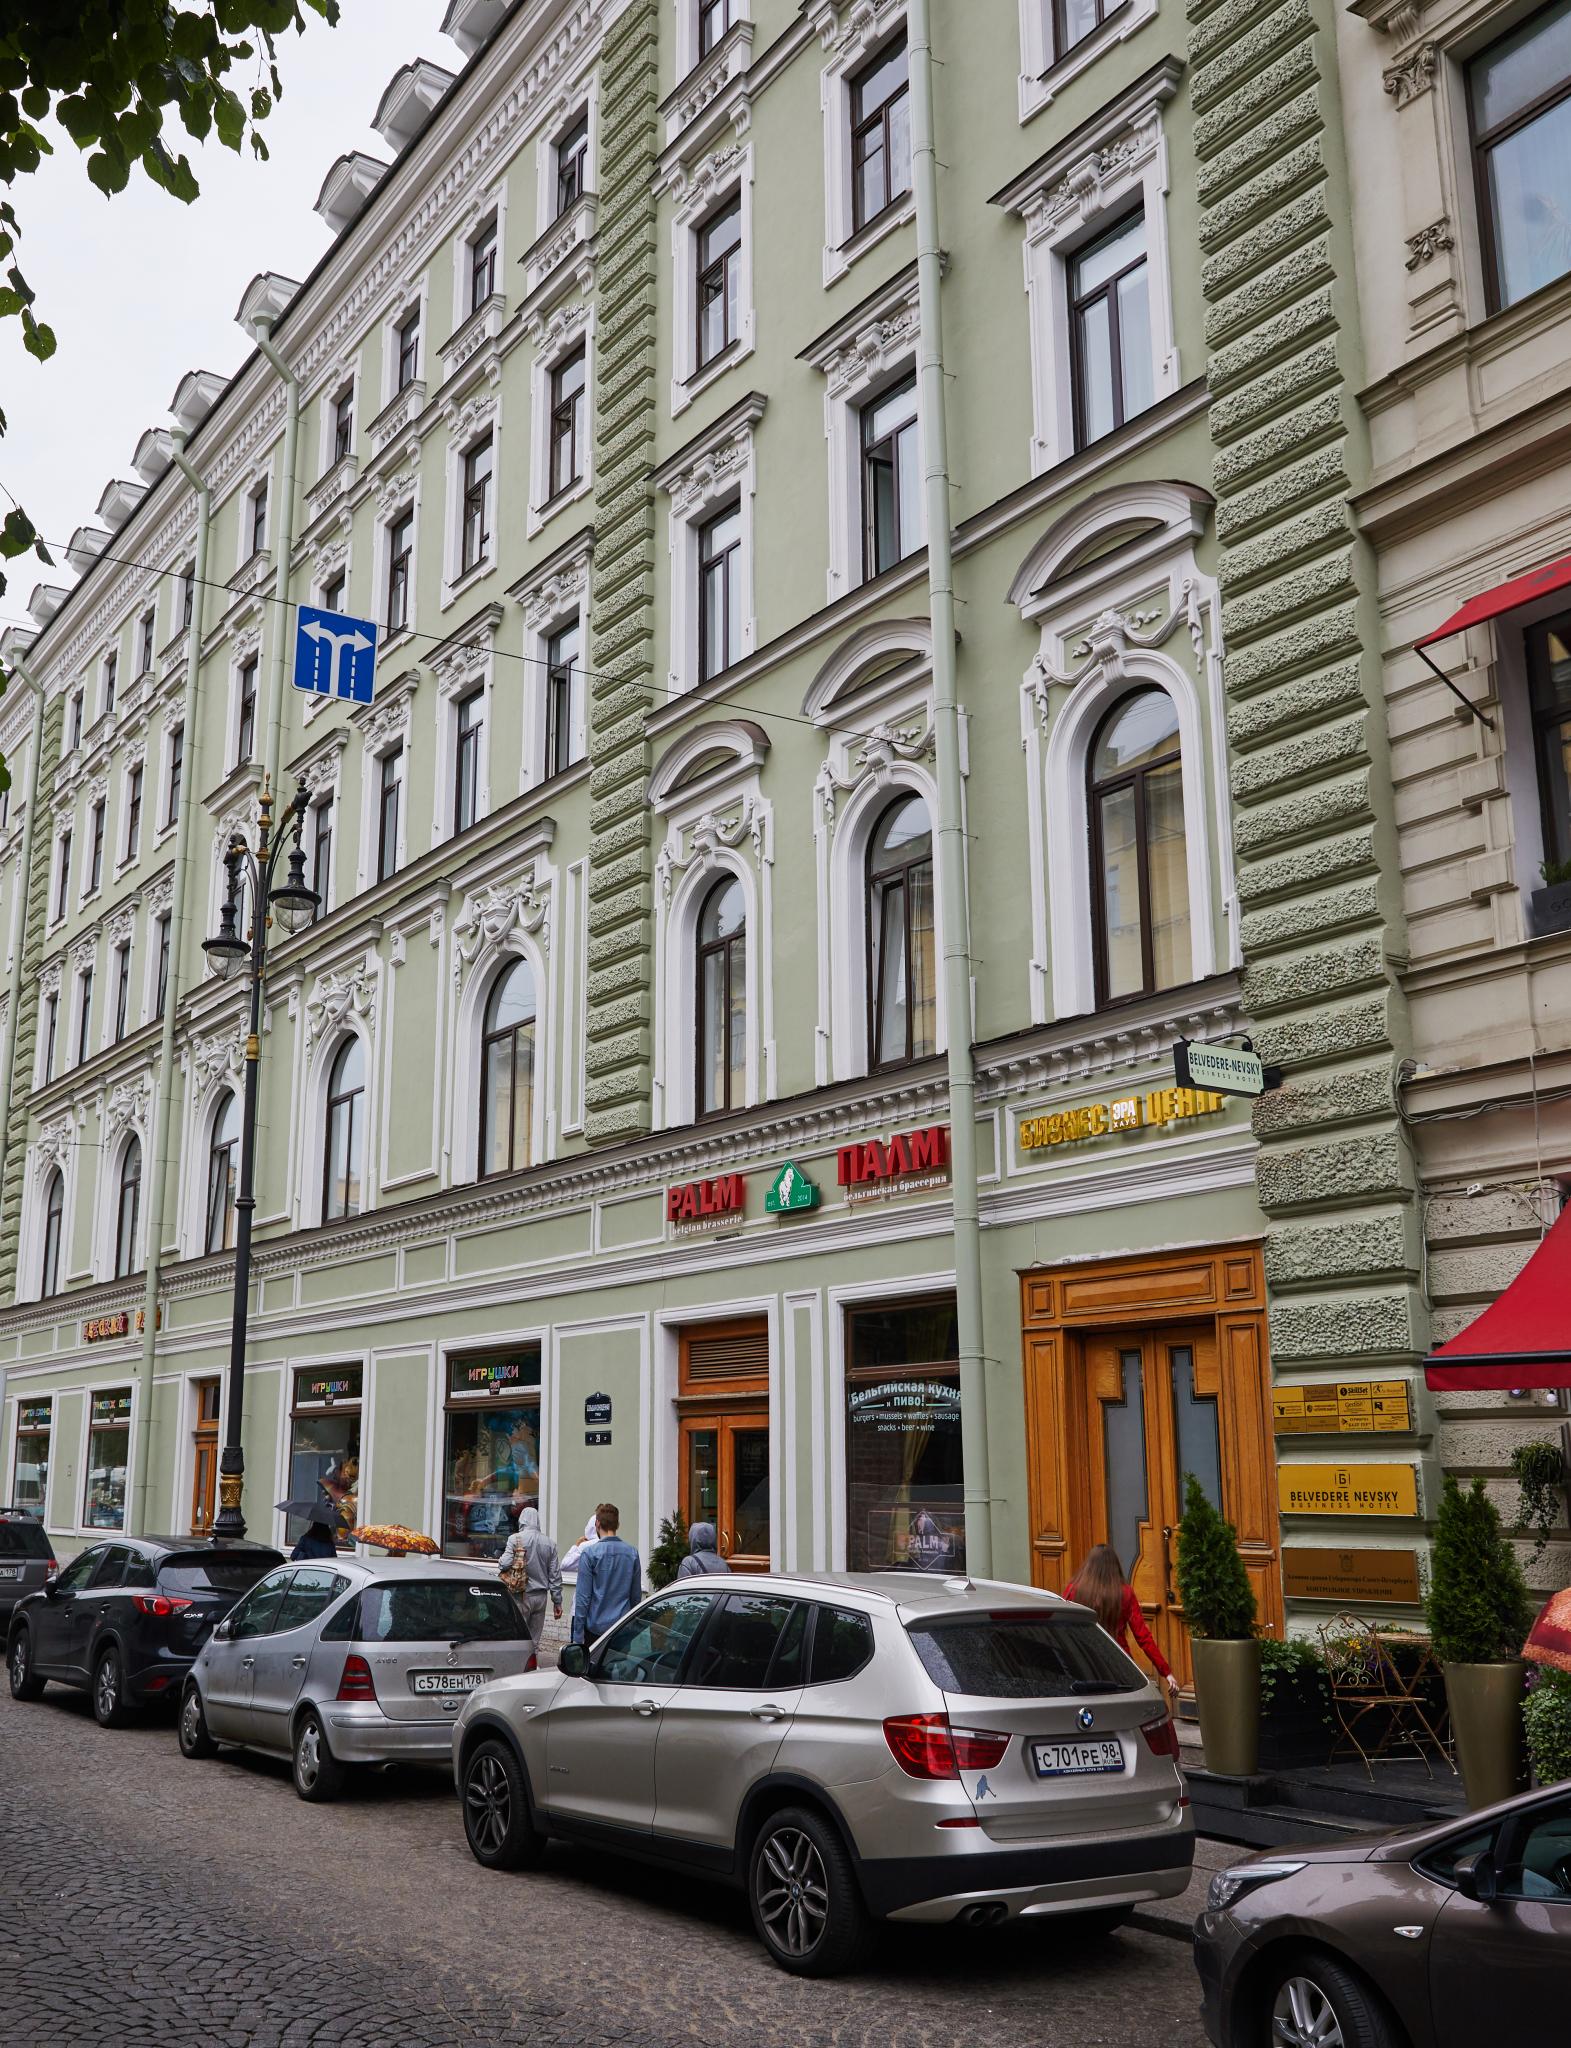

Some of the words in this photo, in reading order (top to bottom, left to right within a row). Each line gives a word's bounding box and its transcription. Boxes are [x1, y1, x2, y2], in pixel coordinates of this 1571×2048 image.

[1189, 1052, 1260, 1075] BELVEDERE-NEVSKY
[1113, 1101, 1136, 1119] ЭРА
[1019, 1104, 1108, 1149] БИЗНЕС
[1113, 1118, 1137, 1128] ХАУС
[837, 1126, 947, 1186] ПАЛМ
[843, 1186, 897, 1201] бельгийская
[899, 1175, 947, 1193] брассерия
[667, 1174, 743, 1221] PALM
[672, 1222, 701, 1236] belgian
[702, 1215, 742, 1229] brasserie
[468, 1365, 519, 1381] ИГРУШКИ
[311, 1380, 349, 1394] ИГРУШКИ
[851, 1382, 924, 1406] Бельгийская
[893, 1394, 925, 1407] пиво!
[853, 1413, 875, 1423] burgers
[879, 1412, 902, 1420] mussels
[907, 1411, 929, 1420] waffles
[877, 1423, 896, 1431] snacks
[901, 1423, 915, 1431] beer
[920, 1423, 935, 1431] wine
[1290, 1491, 1349, 1501] BELVEDERE
[1354, 1491, 1398, 1501] NEVSKY
[908, 1534, 939, 1550] PALM
[1101, 1743, 1116, 1759] 98
